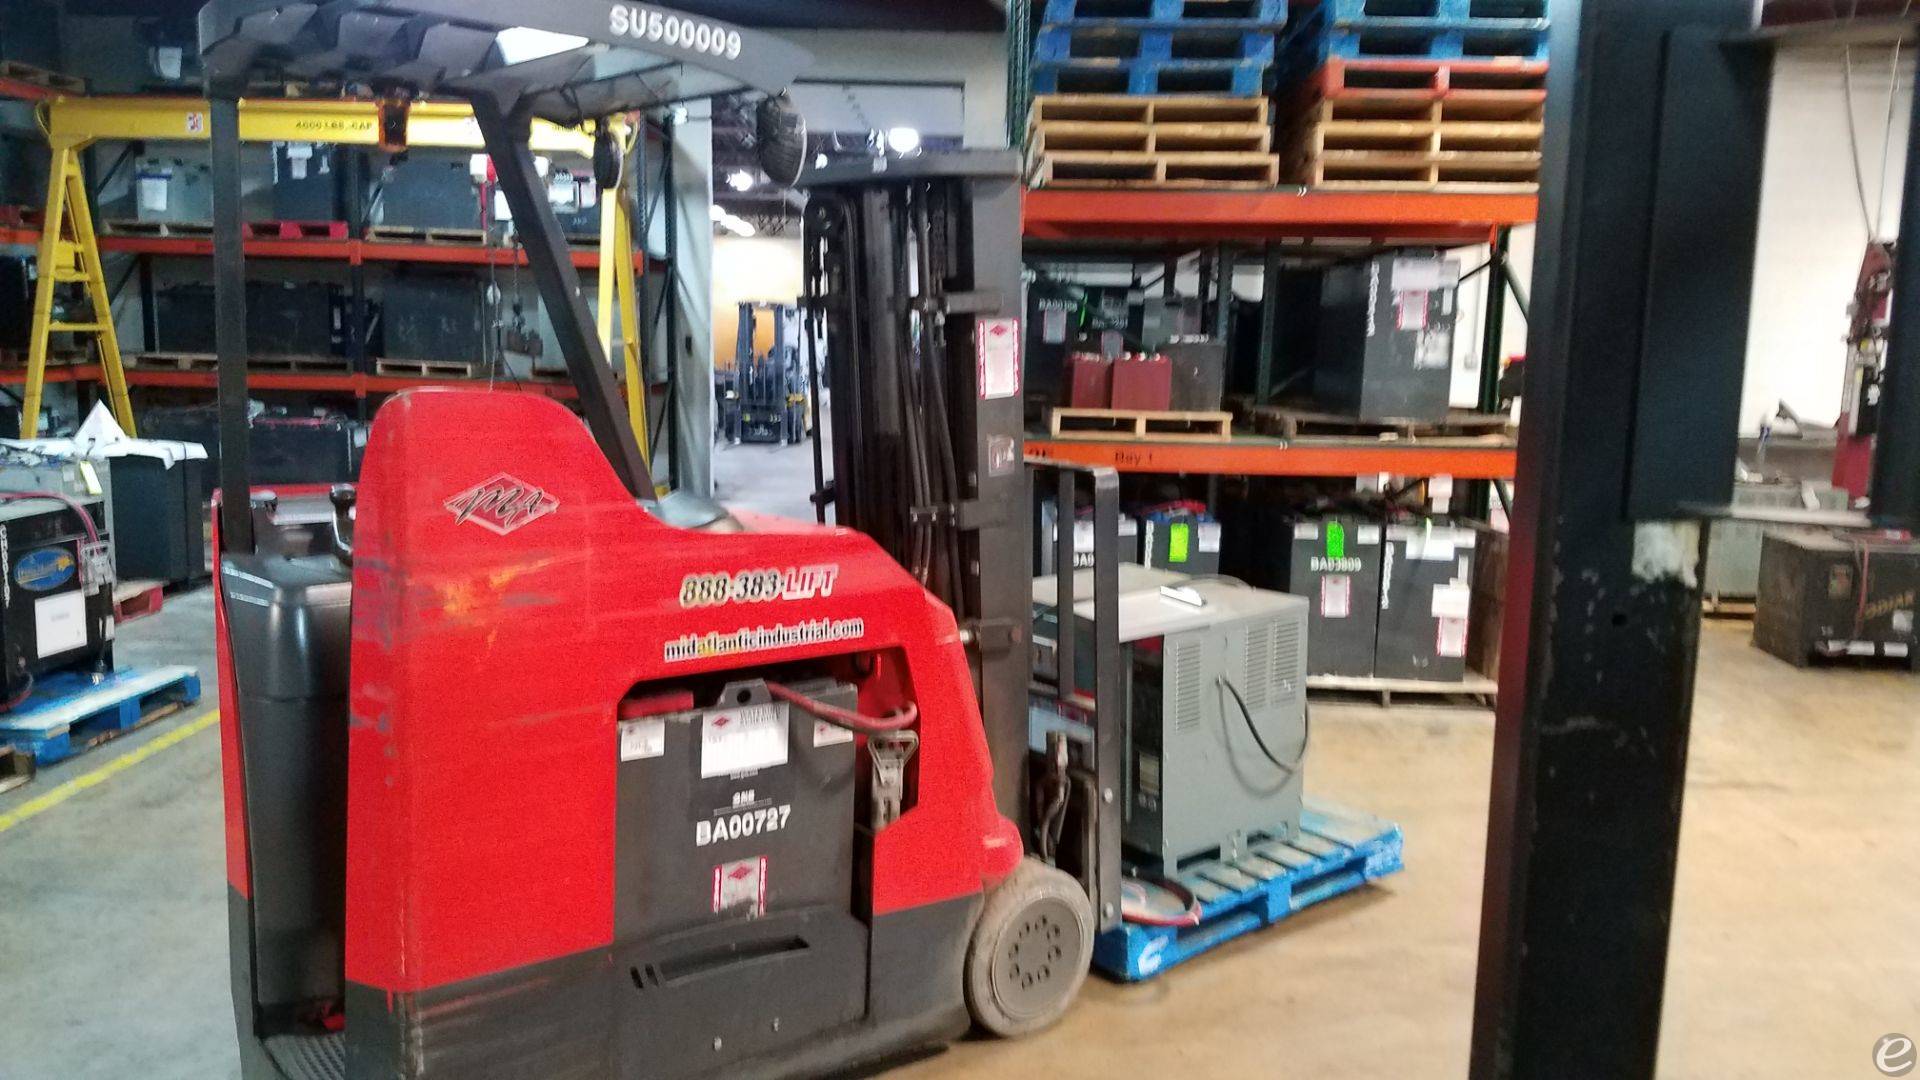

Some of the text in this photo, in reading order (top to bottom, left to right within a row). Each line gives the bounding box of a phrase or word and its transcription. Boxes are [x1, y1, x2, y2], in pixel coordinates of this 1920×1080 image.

[609, 4, 741, 60] SU500009
[1115, 451, 1142, 466] Bay
[664, 617, 864, 662] midatlanticindustrial.com
[696, 804, 791, 846] BA00727
